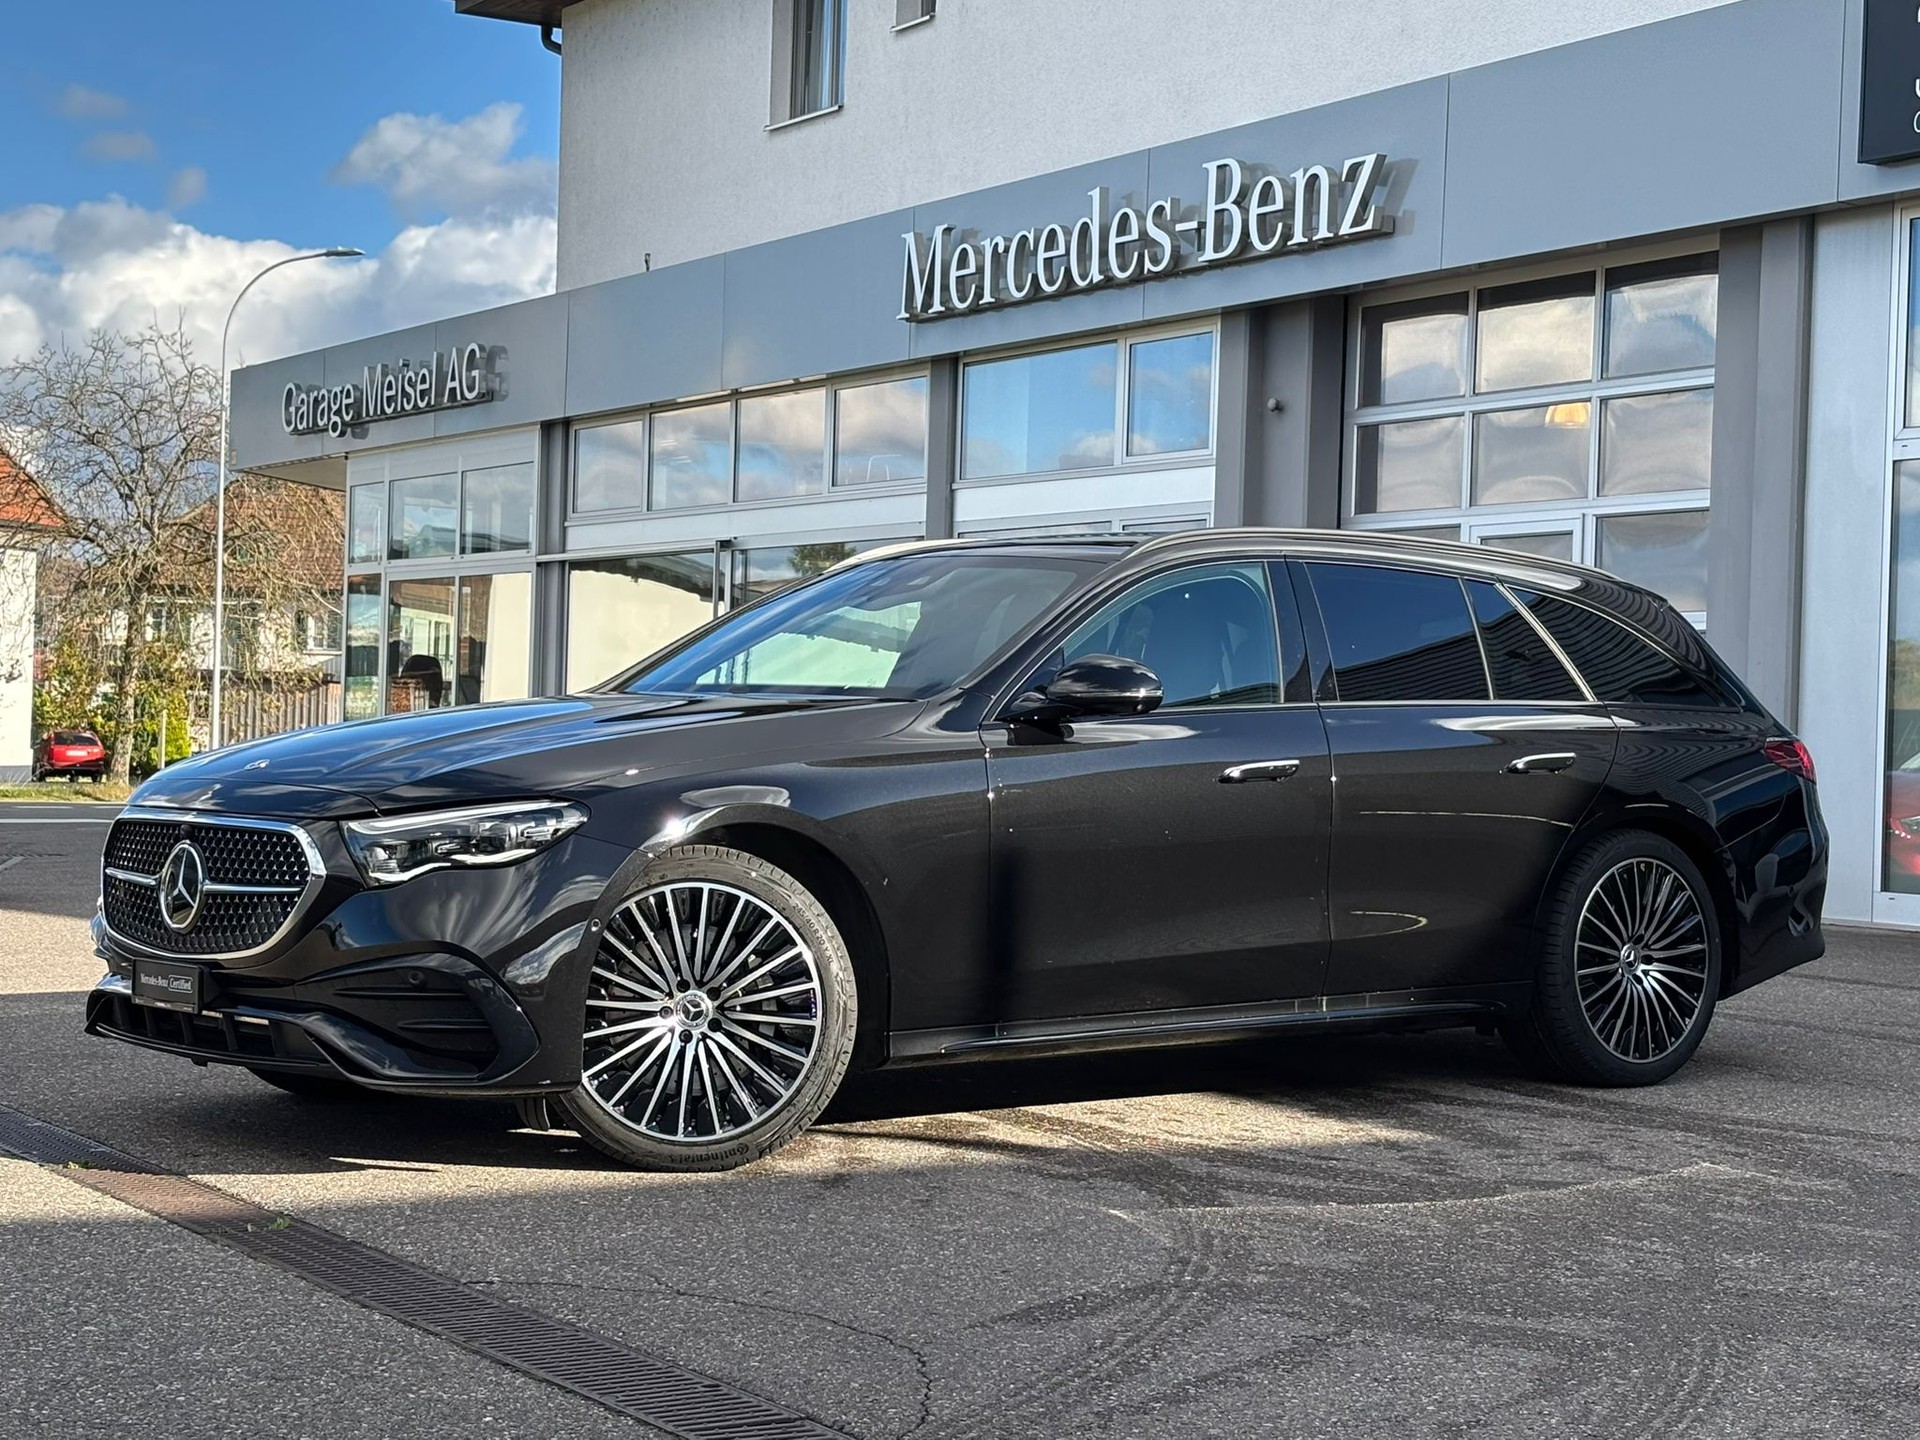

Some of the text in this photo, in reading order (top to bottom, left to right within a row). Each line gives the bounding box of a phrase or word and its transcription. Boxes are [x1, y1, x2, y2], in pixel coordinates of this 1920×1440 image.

[896, 152, 1388, 320] Mercedes-Benz
[281, 342, 482, 438] Garage Meisel AG
[170, 978, 191, 990] Certified
[679, 1143, 750, 1163] Continental
